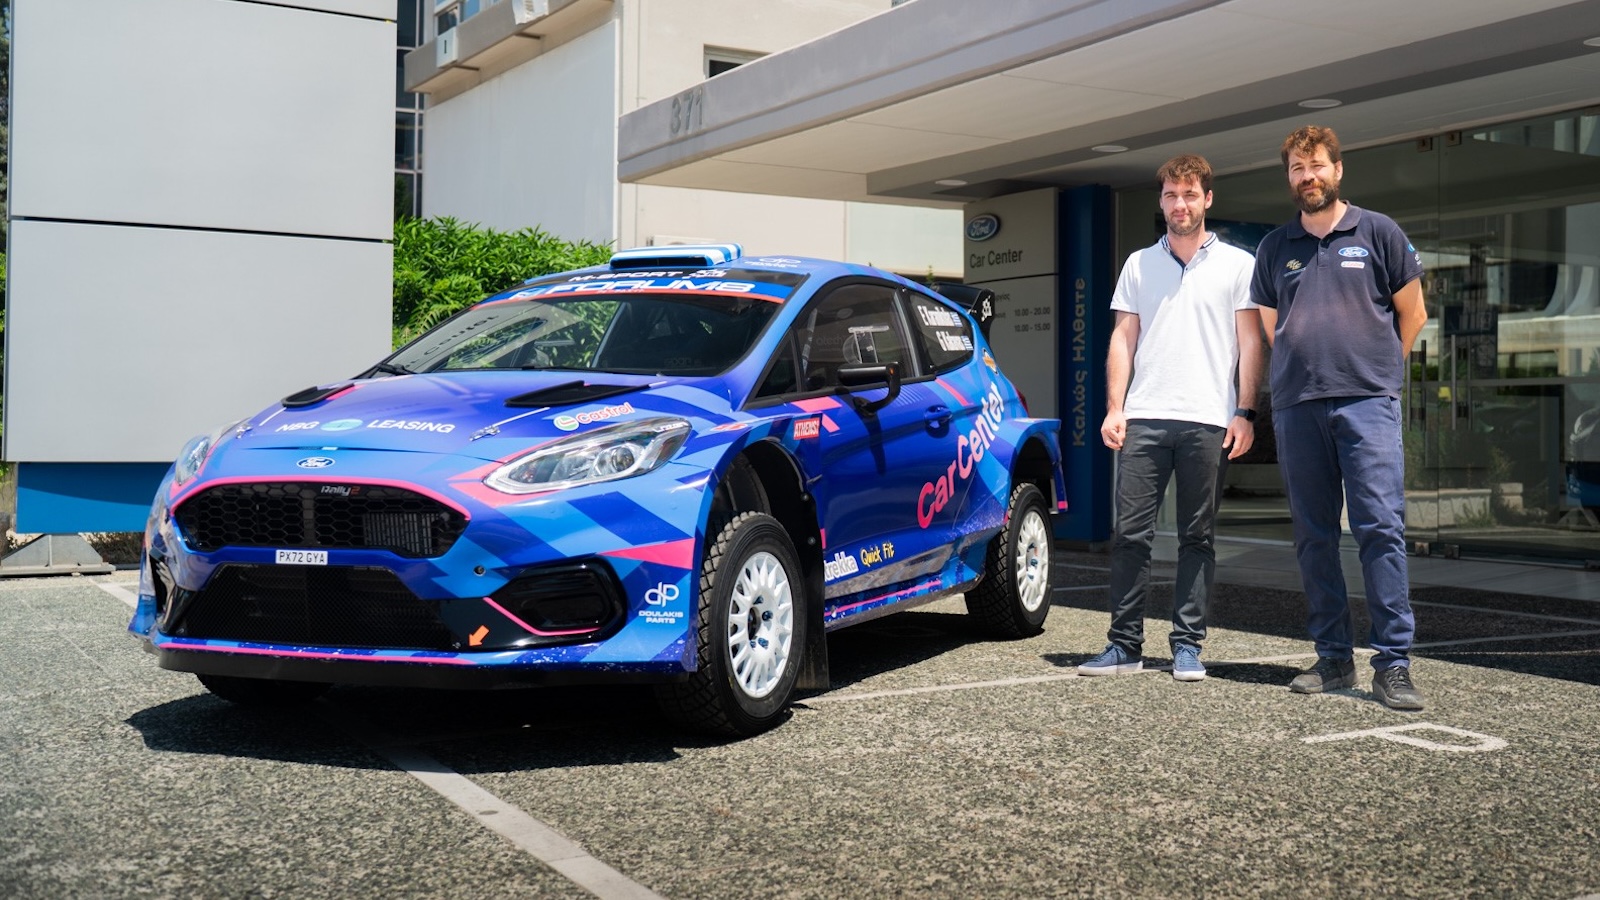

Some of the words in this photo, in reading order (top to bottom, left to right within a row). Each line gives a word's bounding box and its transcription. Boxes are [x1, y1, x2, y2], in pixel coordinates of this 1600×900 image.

[671, 86, 703, 134] 371
[970, 254, 985, 268] Car
[988, 249, 1023, 266] Center
[568, 271, 683, 282] M-SPORT
[545, 277, 756, 295] FORUM8
[576, 402, 635, 424] Castrol
[275, 421, 320, 432] NBG
[367, 419, 456, 433] LEASING
[299, 457, 333, 468] Ford
[321, 485, 361, 496] Rally2
[279, 551, 304, 563] PX72
[306, 552, 326, 563] GYA
[861, 546, 882, 567] Quick
[882, 542, 894, 559] Fit
